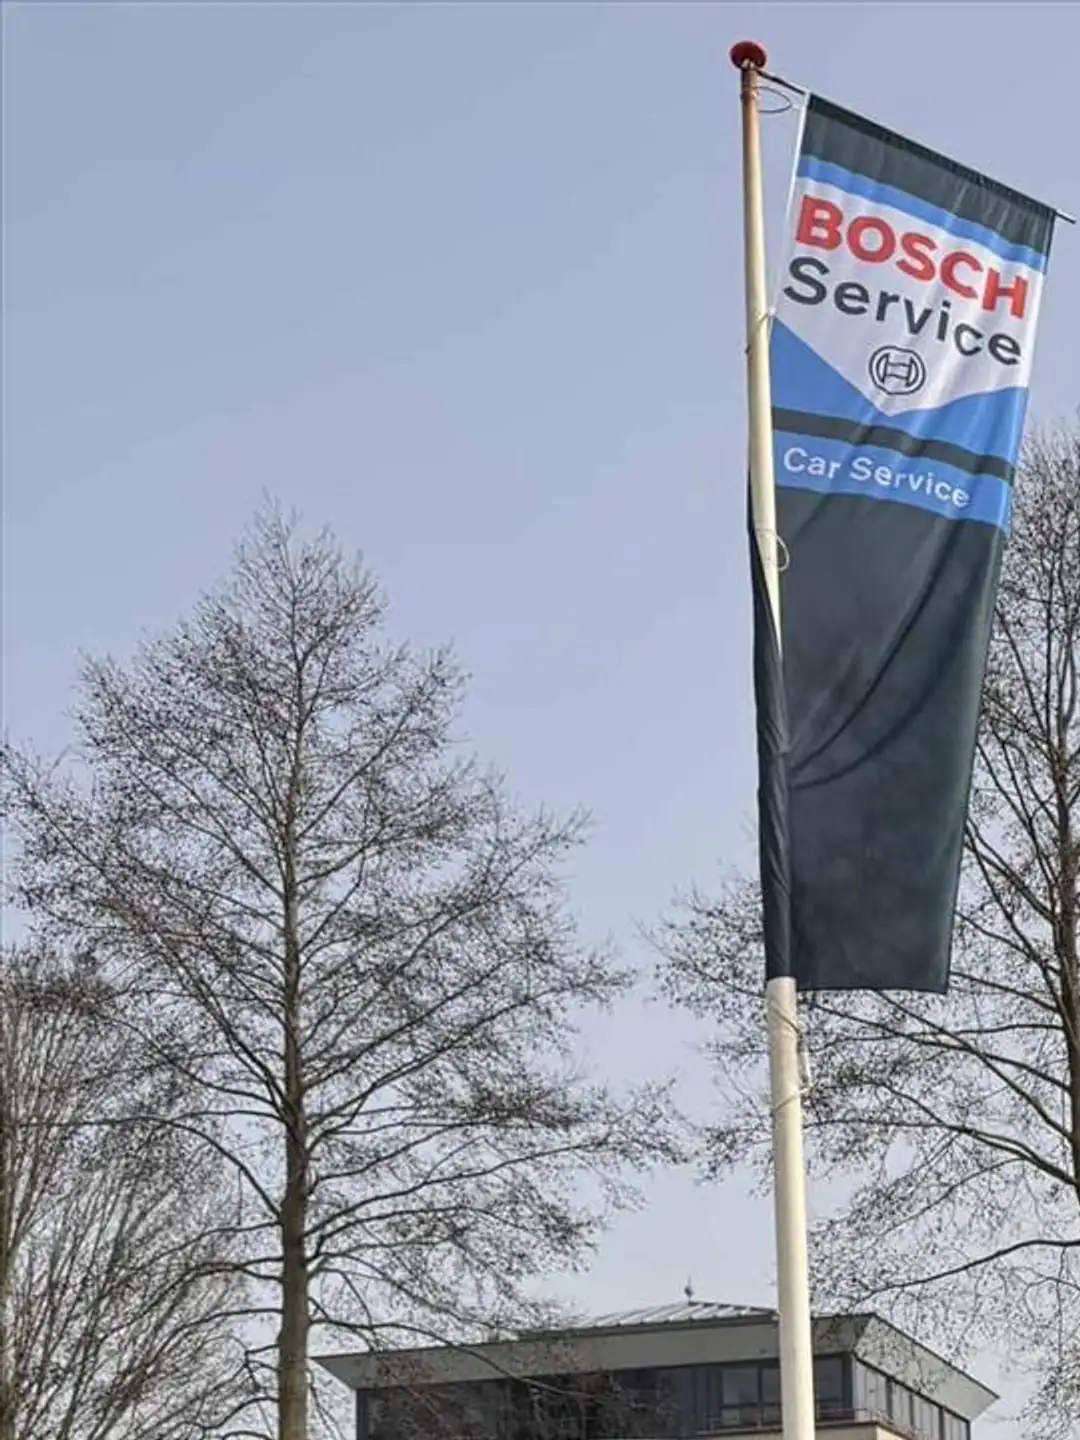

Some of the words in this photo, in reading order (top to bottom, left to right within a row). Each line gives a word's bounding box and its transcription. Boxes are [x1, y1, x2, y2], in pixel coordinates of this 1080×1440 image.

[783, 256, 1022, 366] Service
[796, 194, 1029, 319] BOSCH
[783, 446, 842, 480] Car
[849, 456, 971, 509] Service
